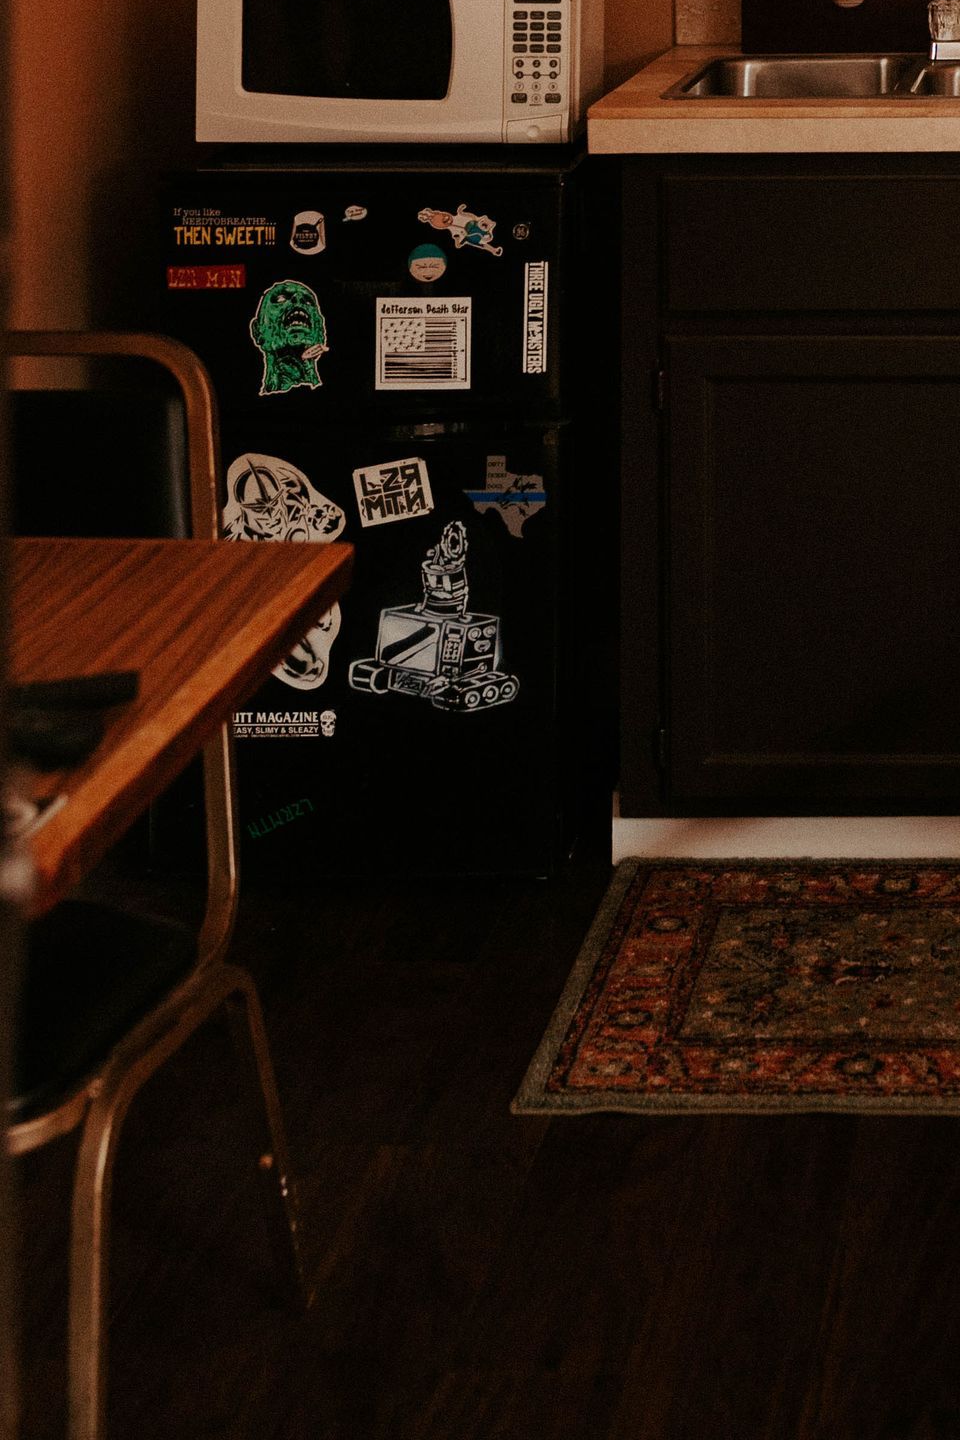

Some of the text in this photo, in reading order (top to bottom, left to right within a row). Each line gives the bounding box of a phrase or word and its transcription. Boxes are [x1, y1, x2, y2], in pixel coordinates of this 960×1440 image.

[183, 209, 201, 217] you
[203, 208, 222, 216] like
[174, 226, 276, 246] THEN SWEET!!!
[528, 261, 545, 291] THREE
[381, 304, 469, 314] Jefferson Death Star
[528, 293, 544, 319] UGLY
[232, 711, 254, 724] UTT
[256, 711, 319, 723] MAGAZINE
[255, 726, 279, 734] SLIMY
[288, 725, 319, 734] SLEAZY
